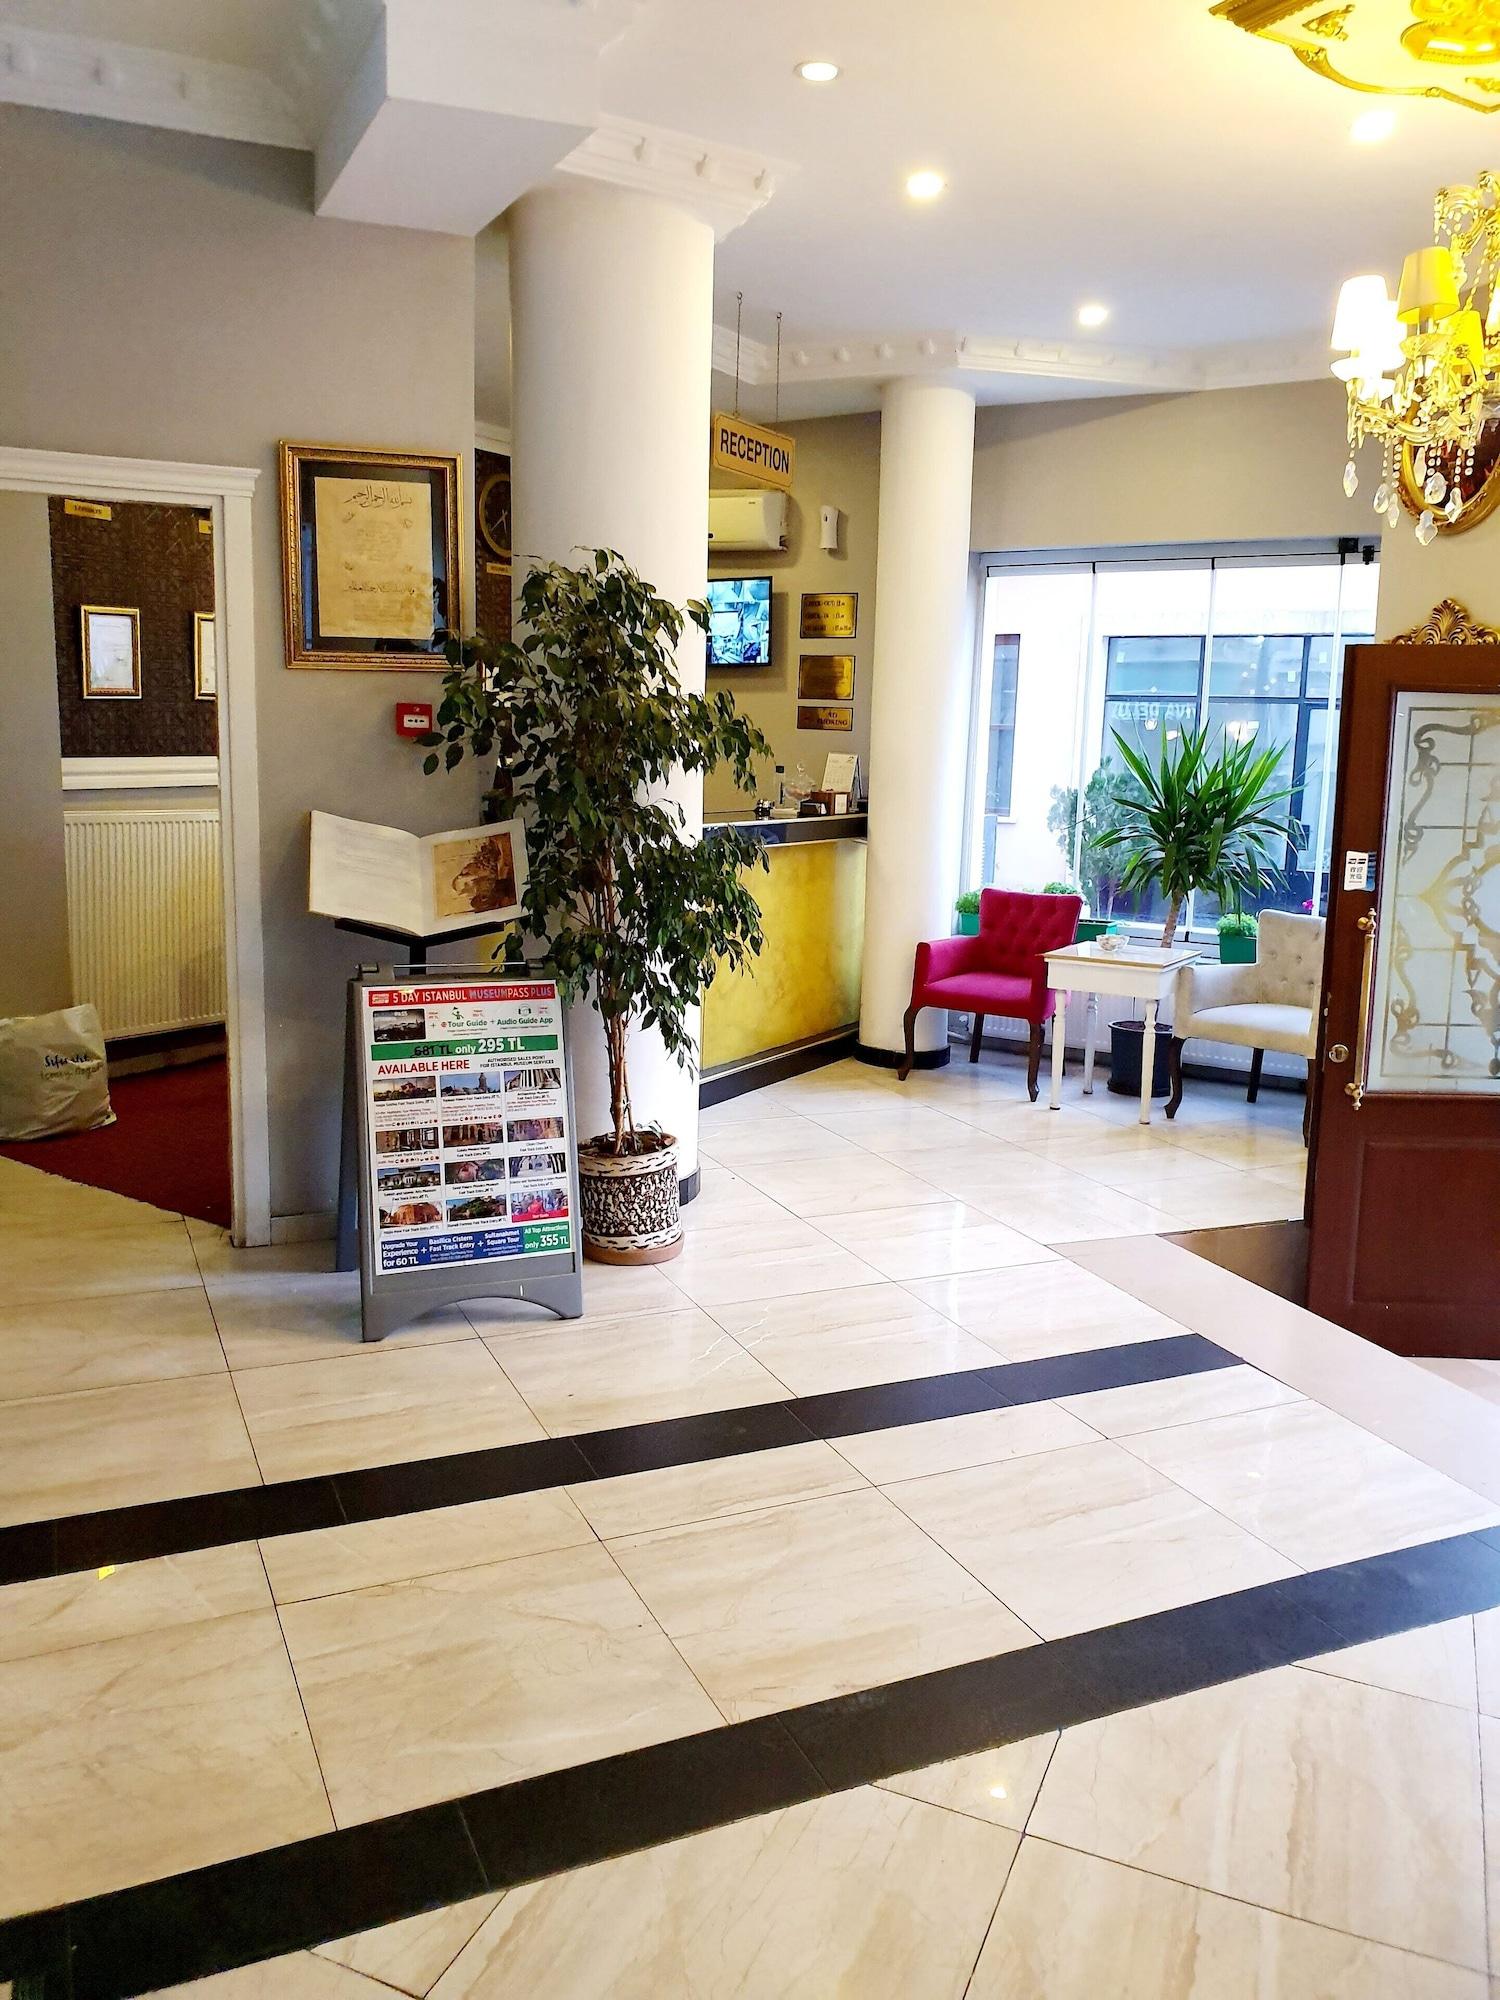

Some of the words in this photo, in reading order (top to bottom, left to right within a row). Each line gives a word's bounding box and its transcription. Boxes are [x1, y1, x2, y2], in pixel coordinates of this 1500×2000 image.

[720, 427, 790, 474] RECEPTION
[392, 992, 399, 1003] 5
[401, 991, 420, 1003] DAY
[422, 989, 467, 1001] ISTANBUL
[530, 986, 552, 998] PLUS
[466, 1018, 488, 1027] Guide
[497, 1017, 518, 1026] Audio
[518, 1016, 538, 1025] Guide
[539, 1015, 554, 1025] App
[455, 1044, 476, 1055] only
[478, 1038, 504, 1052] 295
[507, 1037, 525, 1050] TL
[378, 1061, 439, 1075] AVAILABLE
[441, 1059, 470, 1071] HERE
[542, 1224, 568, 1232] Attractions
[429, 1237, 451, 1245] Basilica
[452, 1234, 473, 1243] Cistern
[484, 1229, 520, 1239] Sultanahmet
[382, 1242, 405, 1251] Upgrade
[406, 1240, 419, 1248] Your
[443, 1243, 459, 1251] Track
[459, 1241, 475, 1250] Entry
[486, 1238, 506, 1247] Square
[507, 1236, 520, 1244] Tour
[524, 1241, 539, 1249] only
[540, 1234, 558, 1246] 355
[559, 1236, 568, 1244] TL
[383, 1247, 419, 1258] Experience
[383, 1259, 395, 1267] for
[396, 1257, 408, 1265] 60
[408, 1256, 419, 1265] TL
